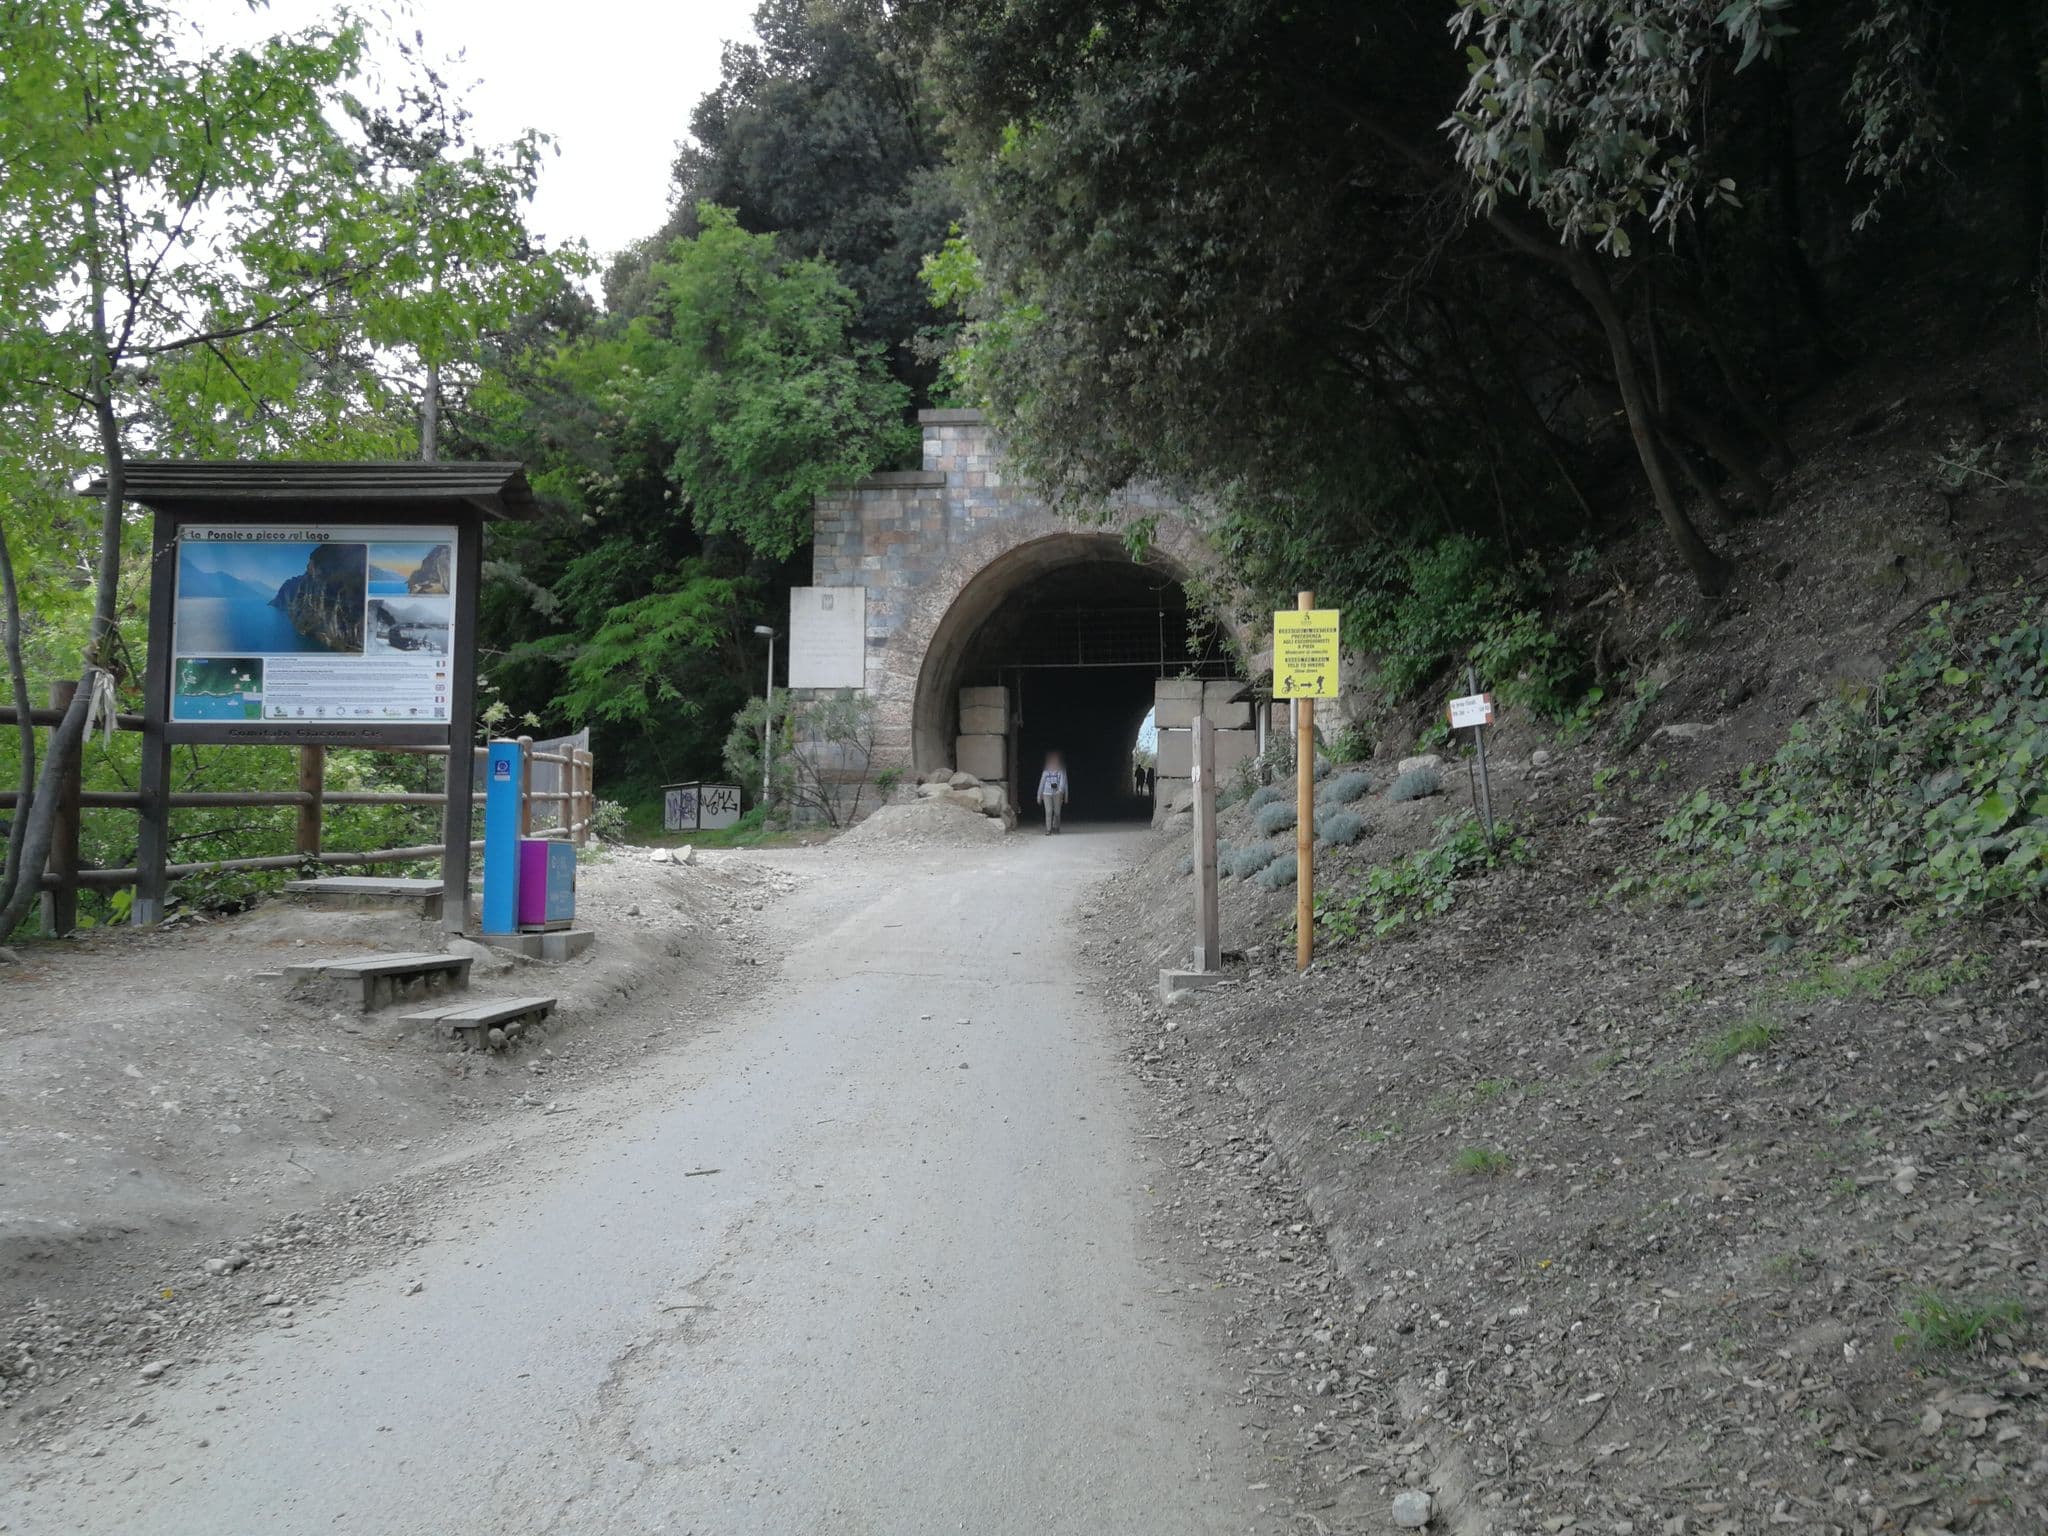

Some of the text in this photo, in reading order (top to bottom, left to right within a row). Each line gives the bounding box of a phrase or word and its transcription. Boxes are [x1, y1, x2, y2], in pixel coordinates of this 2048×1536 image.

[207, 530, 244, 540] Ponale
[246, 532, 253, 540] a
[256, 530, 286, 541] picco
[289, 530, 303, 540] sul
